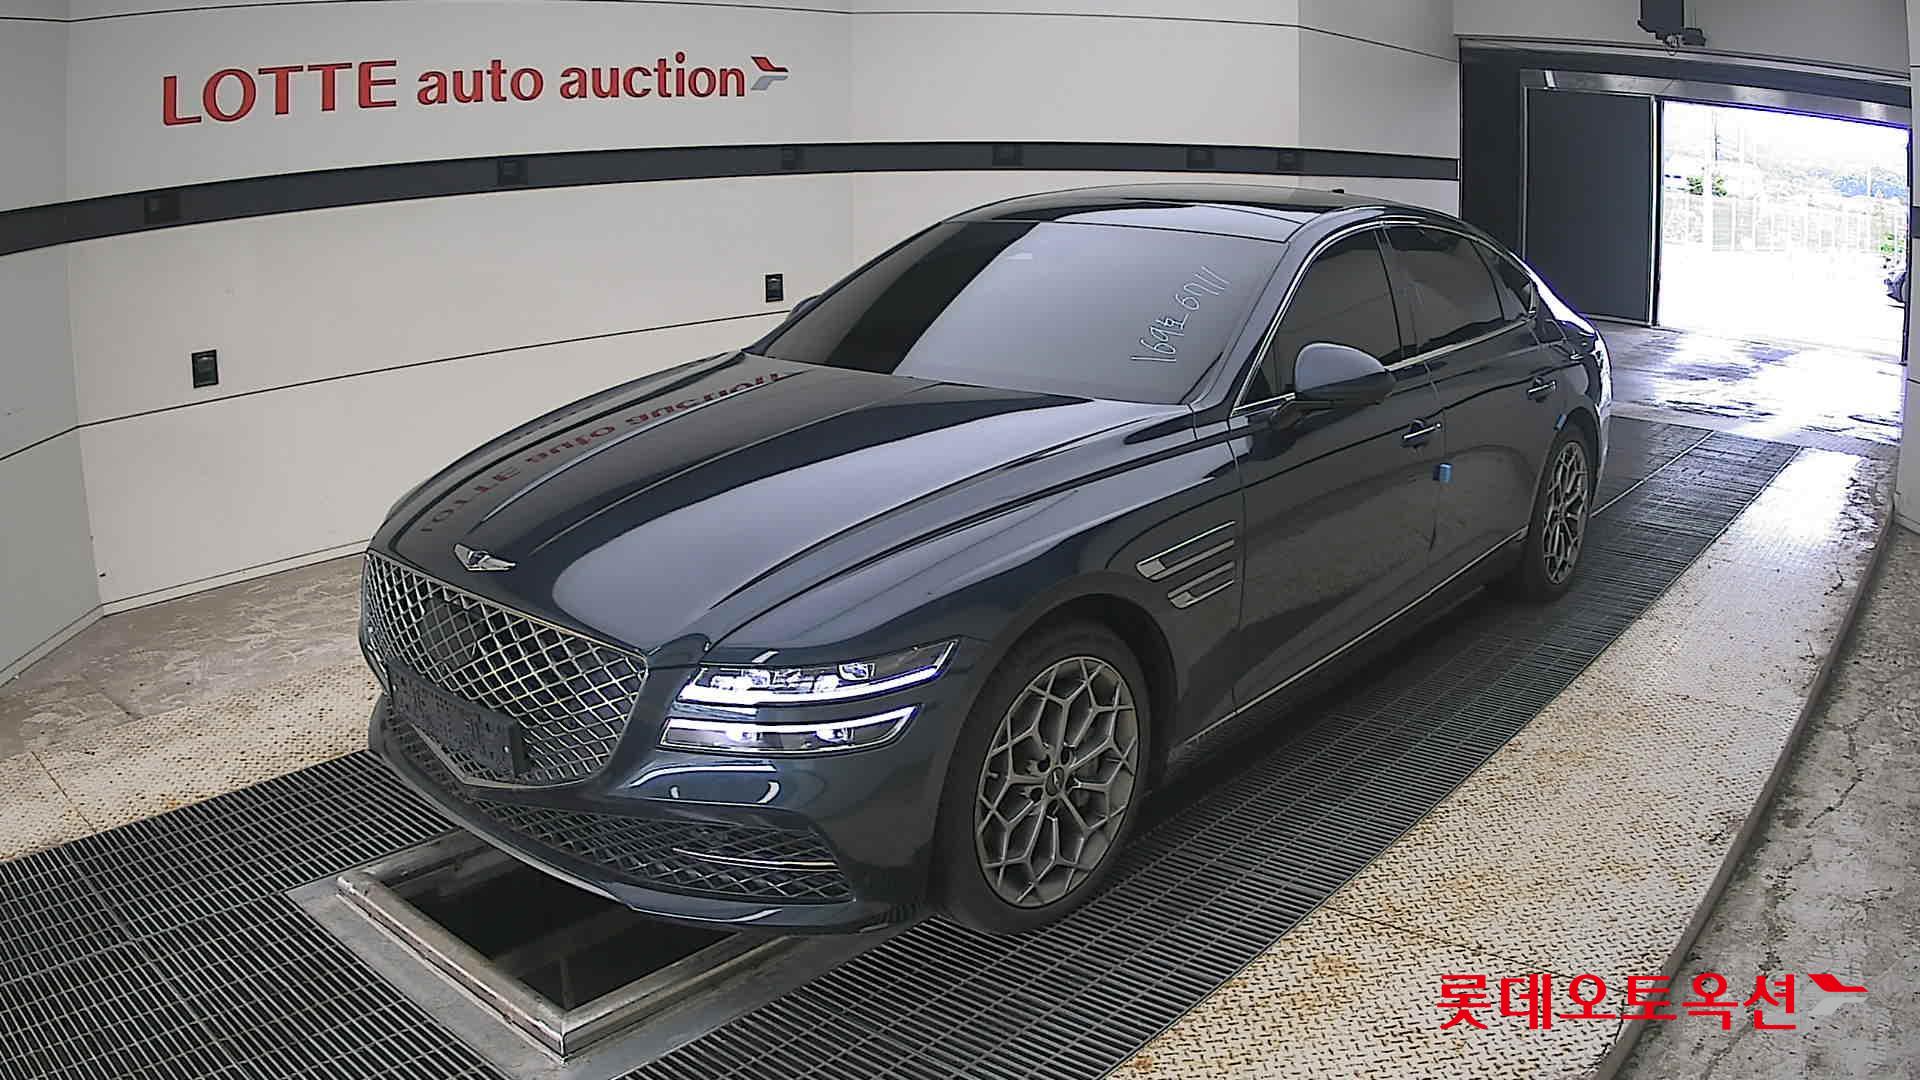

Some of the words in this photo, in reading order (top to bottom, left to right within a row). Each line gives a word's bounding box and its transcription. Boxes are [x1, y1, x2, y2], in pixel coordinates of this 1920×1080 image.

[163, 60, 397, 125] LOTTE
[416, 59, 545, 106] auto
[559, 51, 746, 99] auction
